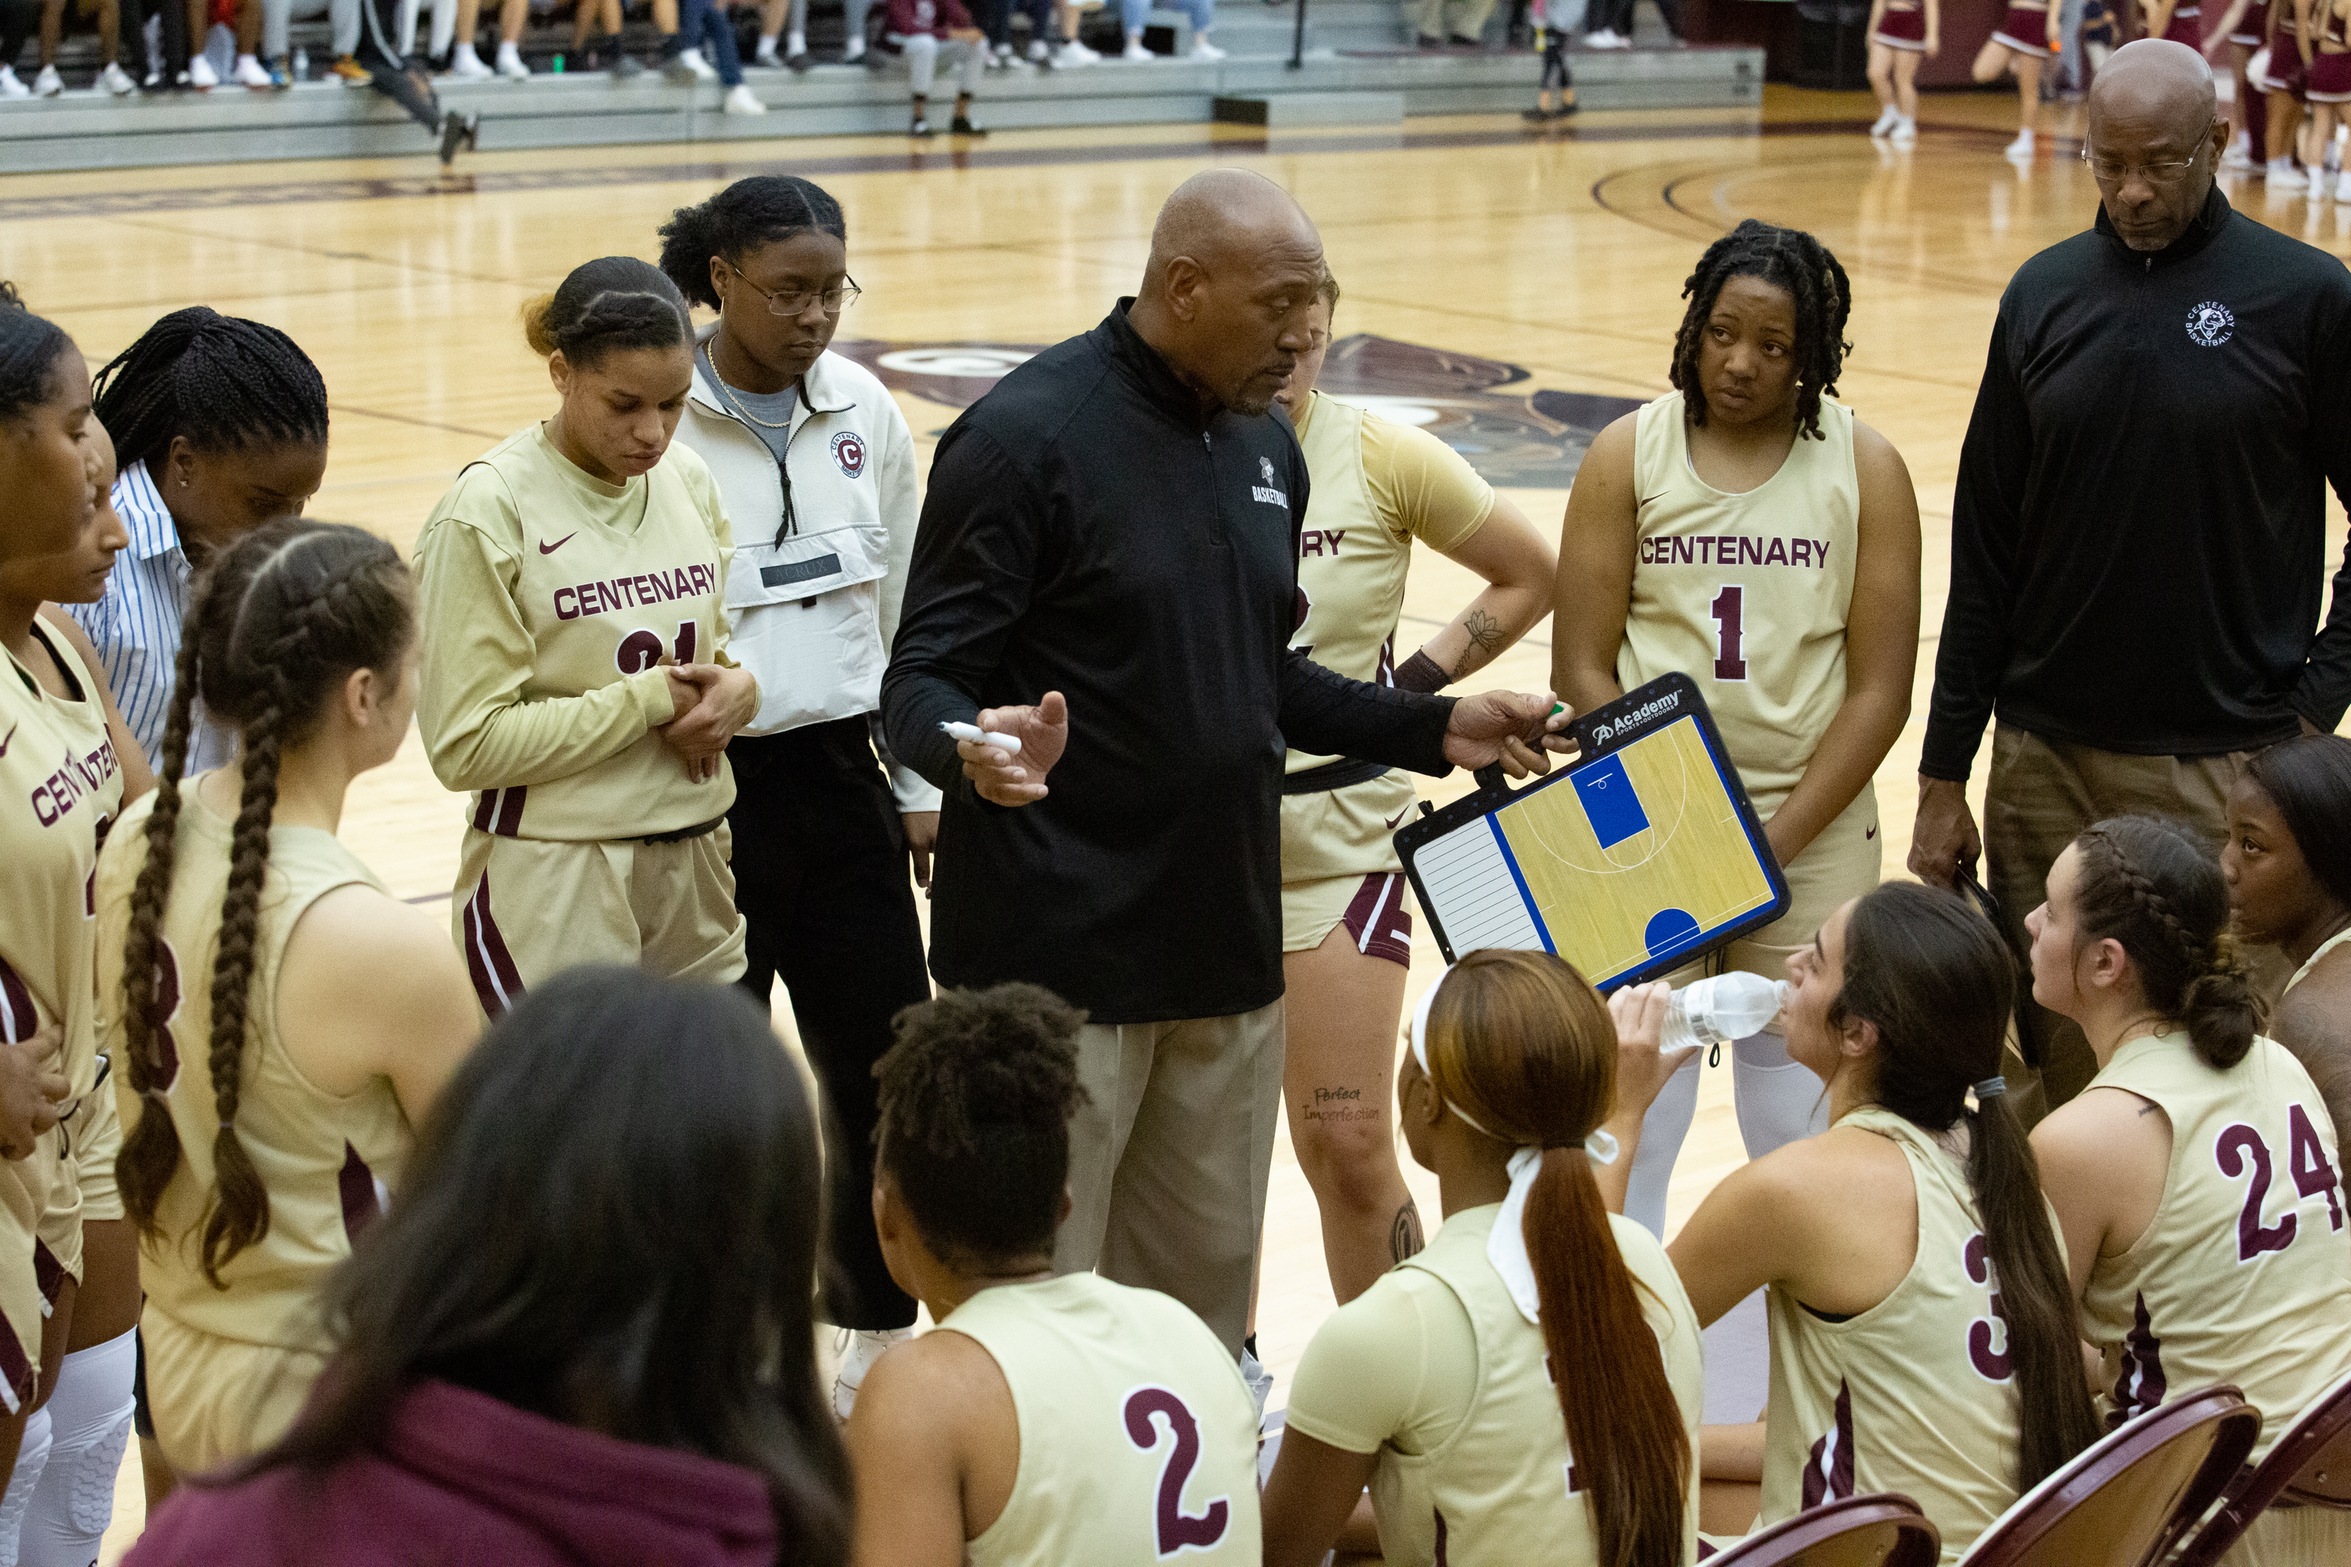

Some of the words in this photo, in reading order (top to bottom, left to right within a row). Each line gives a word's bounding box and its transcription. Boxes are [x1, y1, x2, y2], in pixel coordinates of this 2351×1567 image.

[2187, 301, 2235, 328] CENTENARY
[2185, 322, 2233, 347] BASKETBALL
[831, 434, 864, 451] CENTENARY
[841, 444, 860, 465] C
[1640, 535, 1831, 569] CENTENARY
[553, 562, 716, 621] CENTENARY
[1710, 583, 1750, 682] 1
[1314, 1087, 1360, 1106] Perfect
[1302, 1105, 1379, 1126] Imperfection
[2214, 1101, 2345, 1265] 24
[1121, 1383, 1231, 1559] 2
